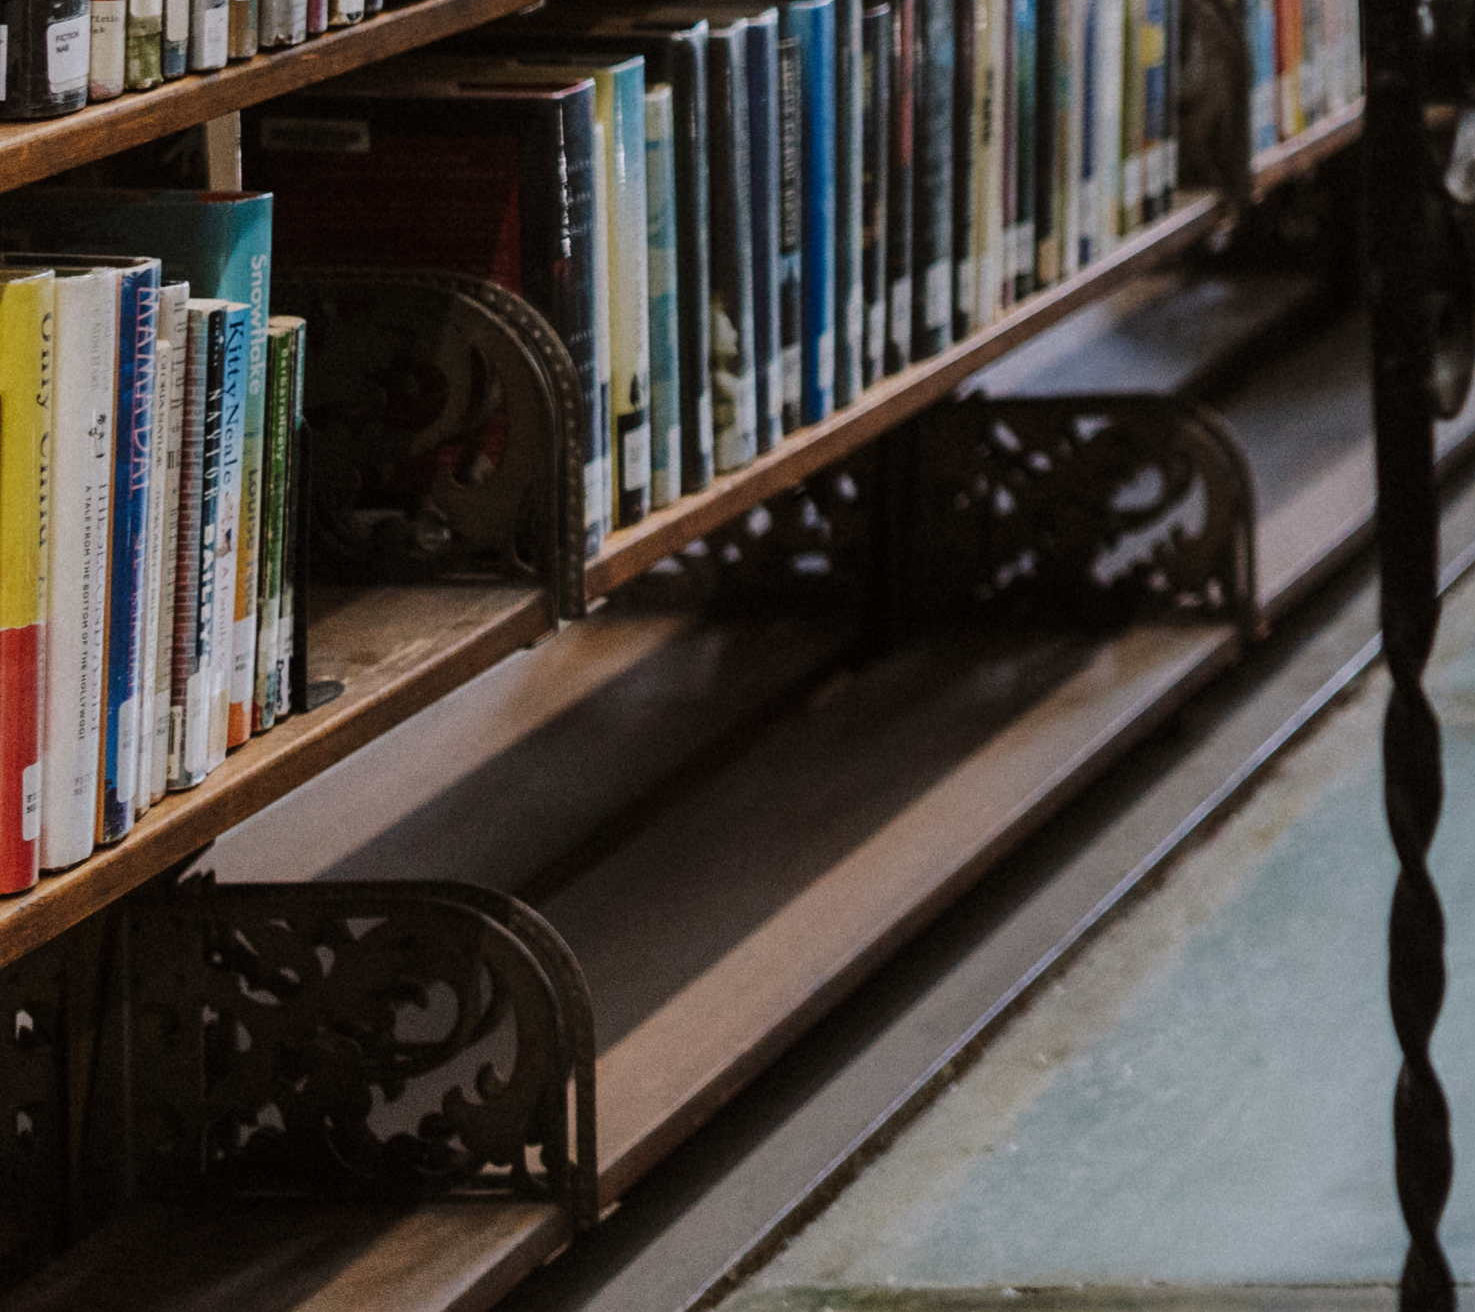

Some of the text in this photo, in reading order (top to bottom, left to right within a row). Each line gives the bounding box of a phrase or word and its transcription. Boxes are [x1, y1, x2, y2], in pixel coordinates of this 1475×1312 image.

[132, 285, 159, 422] MAMA
[225, 320, 248, 397] Kitty
[249, 254, 270, 395] Snowflake
[202, 387, 224, 501] NAYLOR
[221, 403, 241, 485] Neale
[80, 583, 91, 629] BOTTOM
